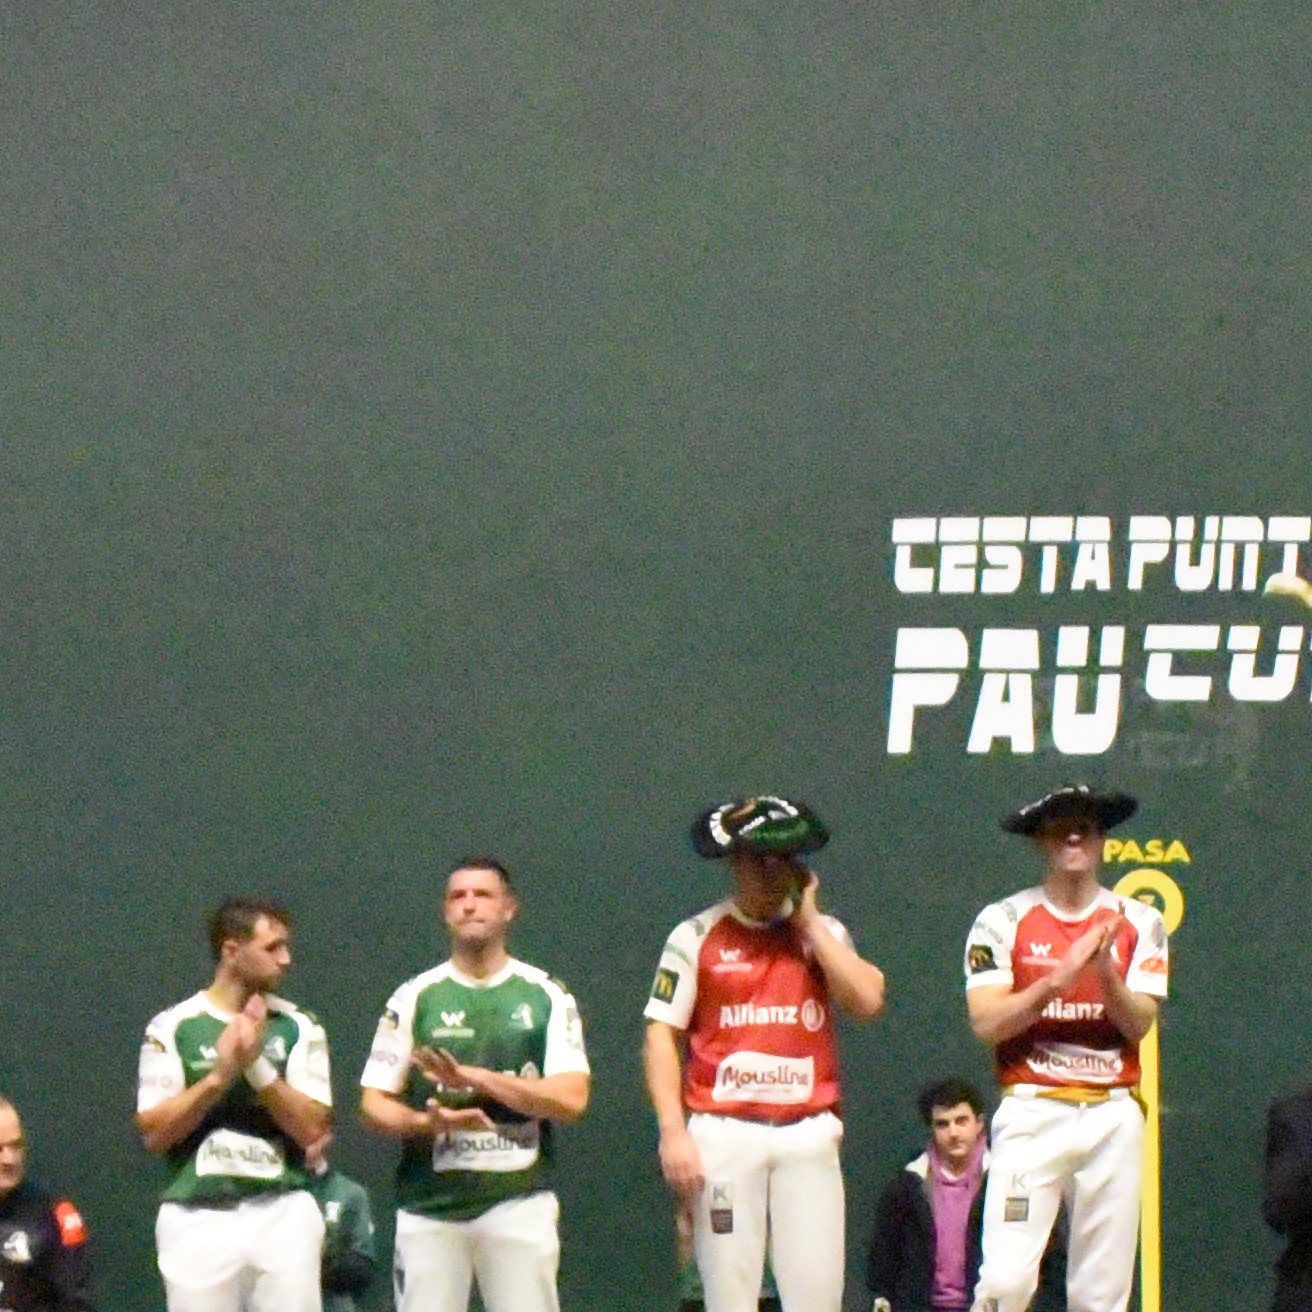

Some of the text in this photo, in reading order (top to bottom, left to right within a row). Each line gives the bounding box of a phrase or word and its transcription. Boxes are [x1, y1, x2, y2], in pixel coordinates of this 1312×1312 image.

[891, 516, 1112, 594] CESTA
[887, 627, 1126, 754] PAU
[1103, 838, 1192, 863] PASA
[719, 1002, 798, 1029] Allianz
